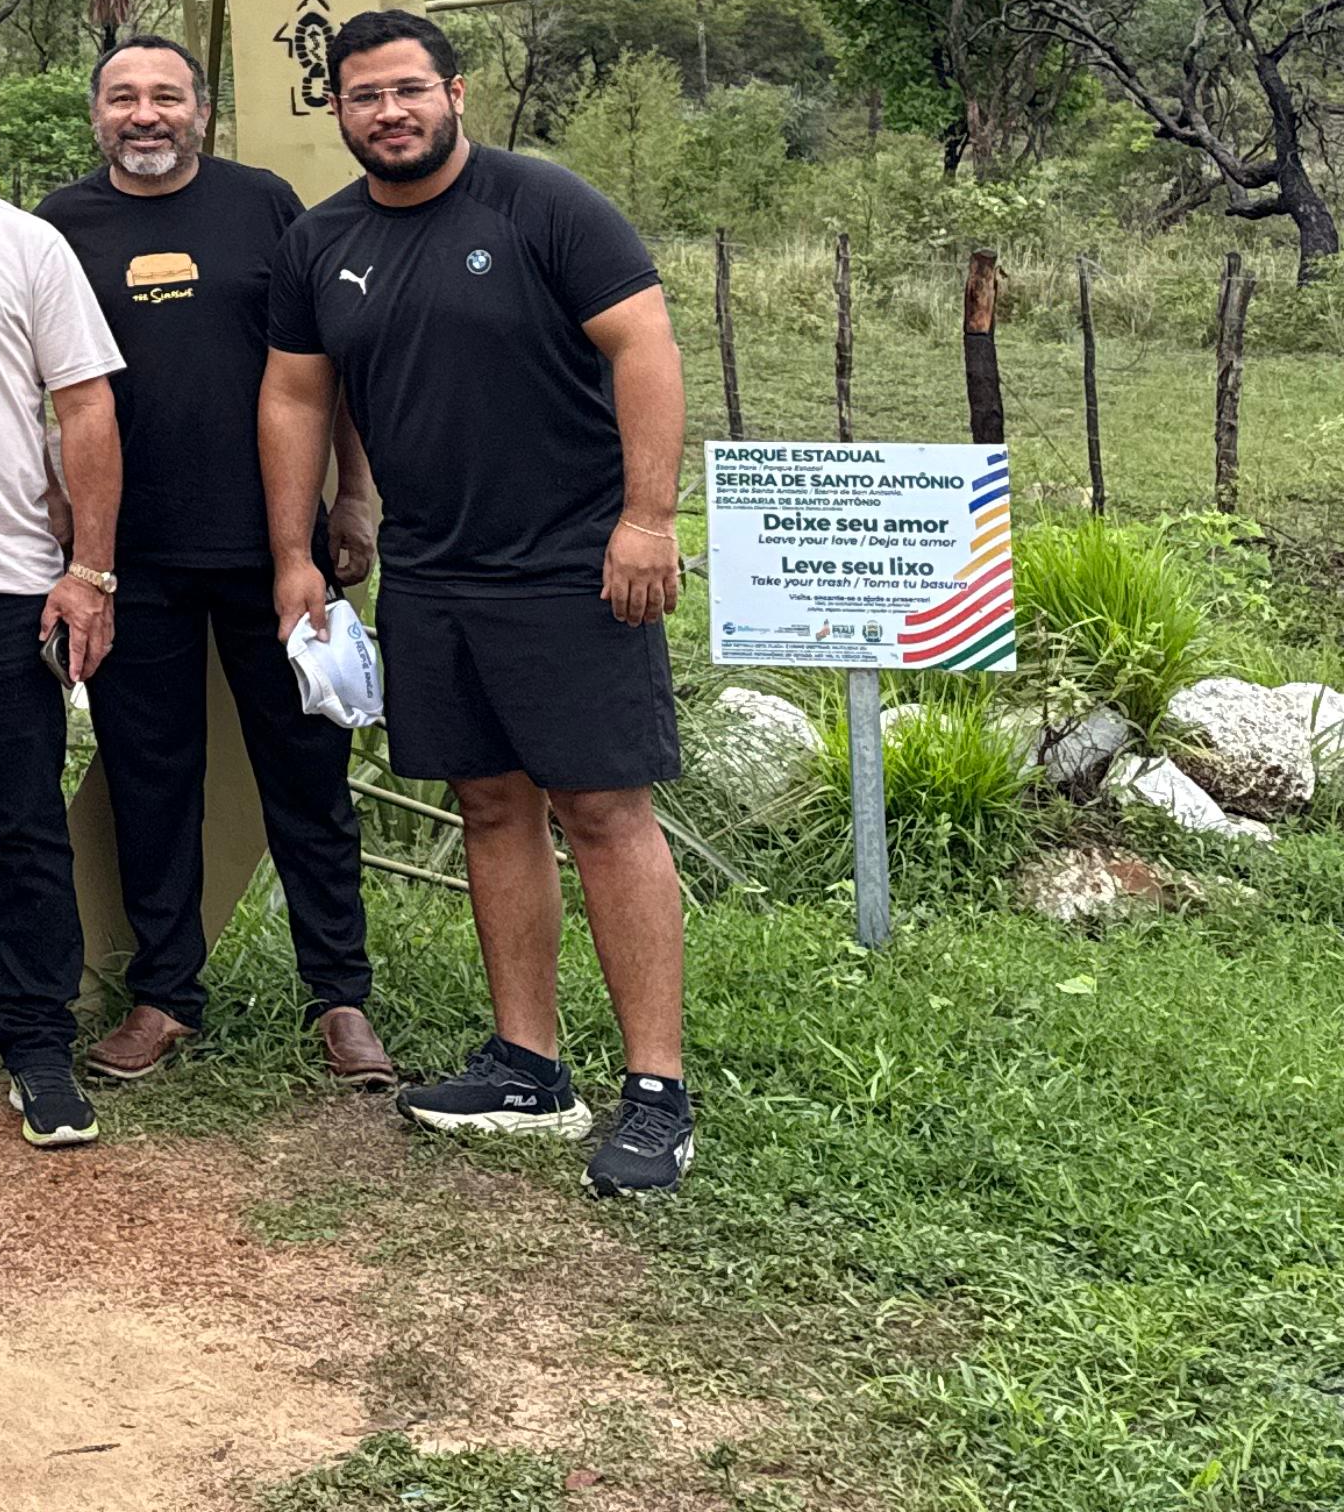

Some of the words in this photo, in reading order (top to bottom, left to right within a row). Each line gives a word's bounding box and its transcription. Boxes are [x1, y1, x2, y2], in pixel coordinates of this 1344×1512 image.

[714, 448, 788, 464] PARQUE
[791, 449, 886, 463] ESTADUAL
[715, 472, 778, 487] SERRA
[781, 474, 807, 487] DE
[810, 474, 874, 488] SANTO
[877, 471, 964, 489] ANTÔNIO
[715, 496, 775, 505] ESCADARIA
[778, 497, 792, 505] DE
[794, 497, 831, 506] SANTO
[763, 511, 831, 531] Deixe
[836, 518, 878, 532] seu
[883, 518, 949, 533] amor
[758, 533, 796, 544] Leave
[798, 536, 829, 547] your
[831, 534, 858, 545] love
[868, 535, 899, 548] Deja
[902, 537, 917, 546] tu
[919, 539, 957, 547] amor
[782, 556, 837, 574] Leve
[841, 561, 883, 575] seu
[889, 556, 934, 576] lixo
[751, 575, 781, 586] Take
[783, 577, 814, 589] your
[816, 576, 851, 587] trash
[862, 577, 900, 588] Toma
[903, 579, 917, 588] tu
[920, 579, 968, 589] basura
[503, 1095, 538, 1106] FILA
